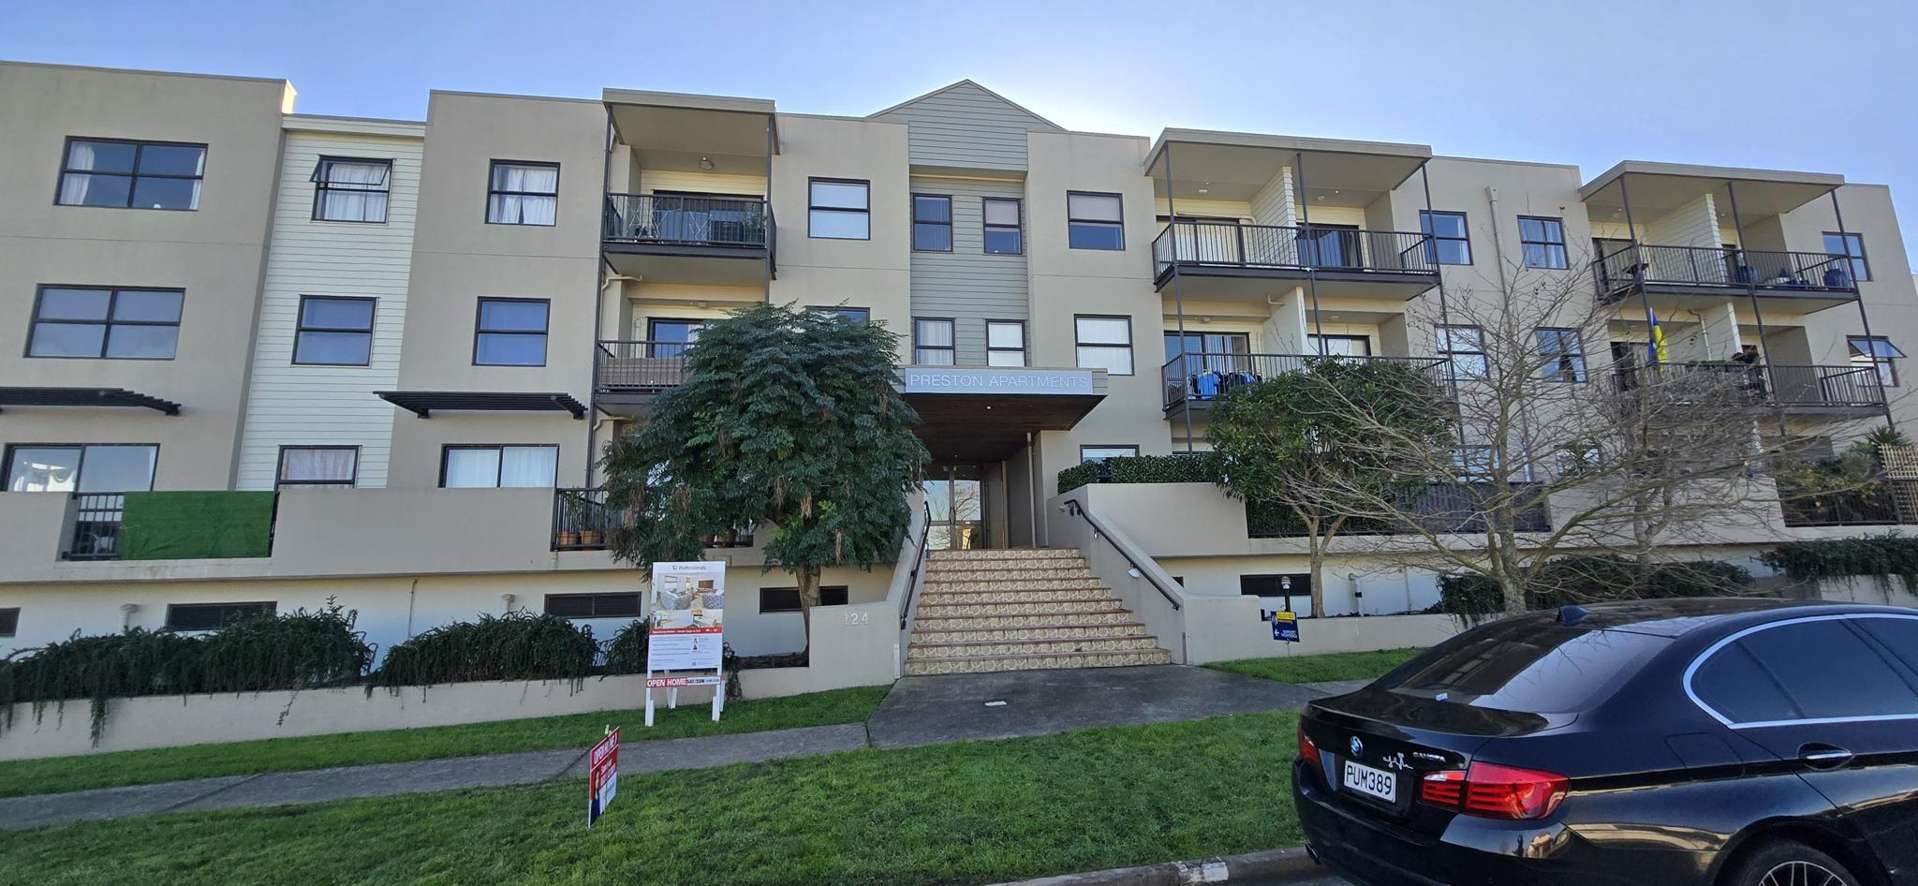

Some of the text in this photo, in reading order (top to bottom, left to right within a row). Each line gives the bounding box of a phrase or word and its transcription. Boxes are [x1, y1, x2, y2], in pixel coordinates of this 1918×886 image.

[910, 374, 1090, 388] PRESTON APARTMENTS
[647, 679, 665, 688] OPEN
[667, 677, 687, 687] HOME
[1347, 764, 1392, 795] PUM389
